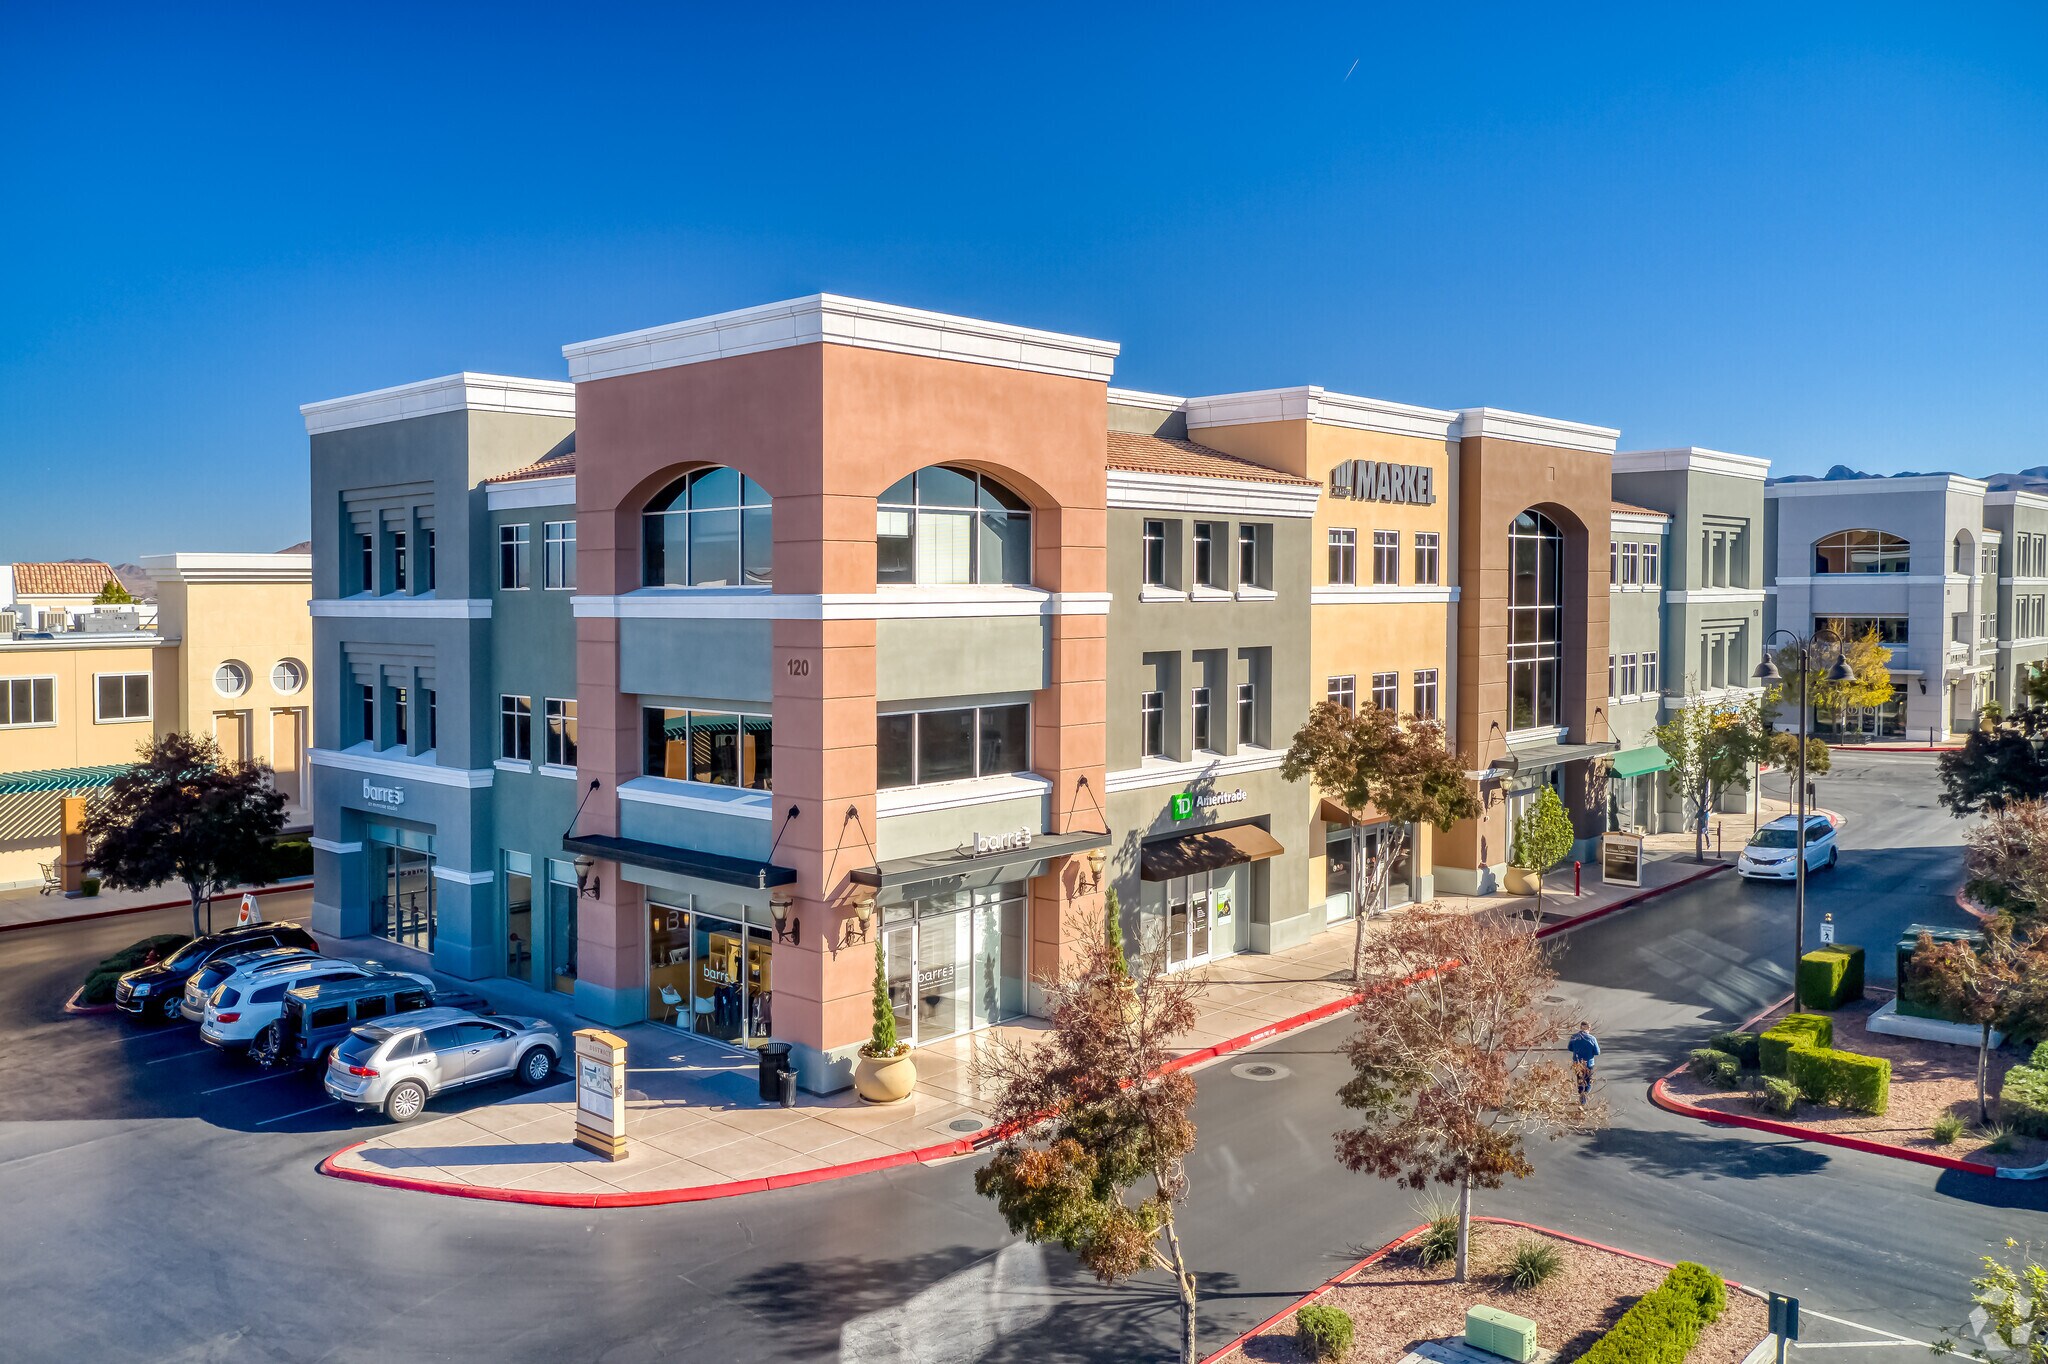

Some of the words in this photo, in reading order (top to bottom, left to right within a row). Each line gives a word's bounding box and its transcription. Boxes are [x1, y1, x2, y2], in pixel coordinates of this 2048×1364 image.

[1353, 459, 1436, 505] MARKEL
[787, 658, 809, 677] 120
[1177, 797, 1191, 815] TD
[1195, 789, 1247, 808] Ameritrade
[589, 1045, 612, 1058] DISTRICT
